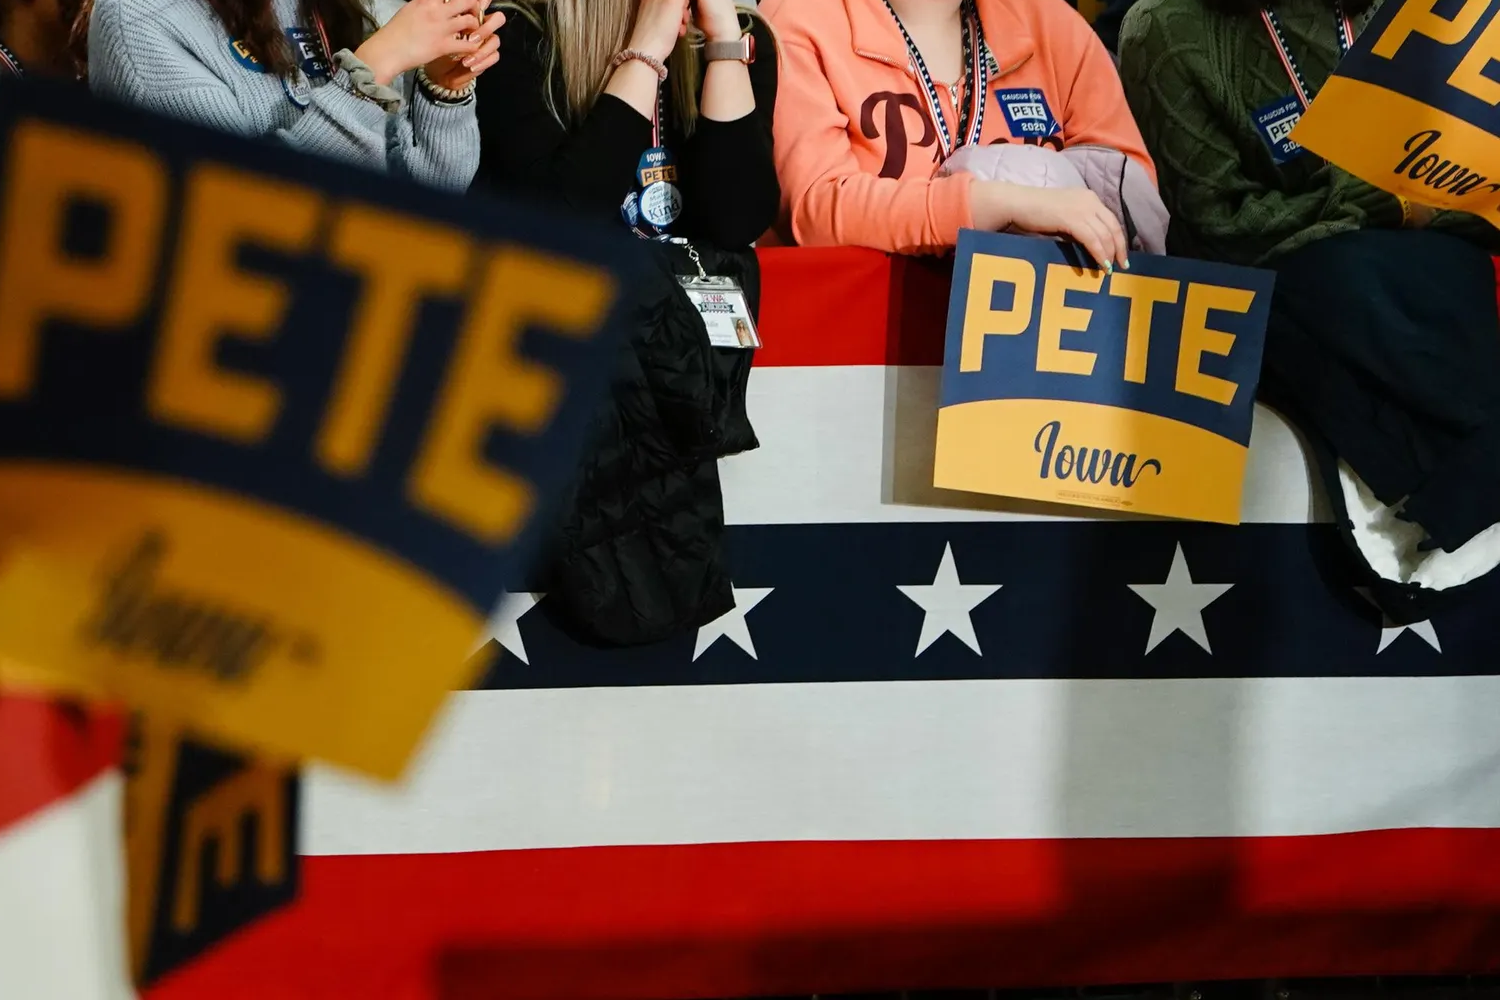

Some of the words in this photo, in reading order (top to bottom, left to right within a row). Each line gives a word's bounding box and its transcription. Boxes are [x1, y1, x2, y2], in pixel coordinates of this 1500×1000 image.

[1001, 93, 1029, 101] CAUCUS
[1012, 105, 1044, 117] PETE
[1258, 106, 1285, 124] CAUCUS
[1285, 101, 1297, 112] FOR
[1021, 122, 1046, 134] 2020
[1282, 141, 1301, 153] 20
[646, 152, 667, 163] IOWA
[644, 167, 674, 182] PETE
[648, 198, 681, 220] Kind
[959, 252, 1256, 406] PETE
[1034, 421, 1161, 488] Iowa
